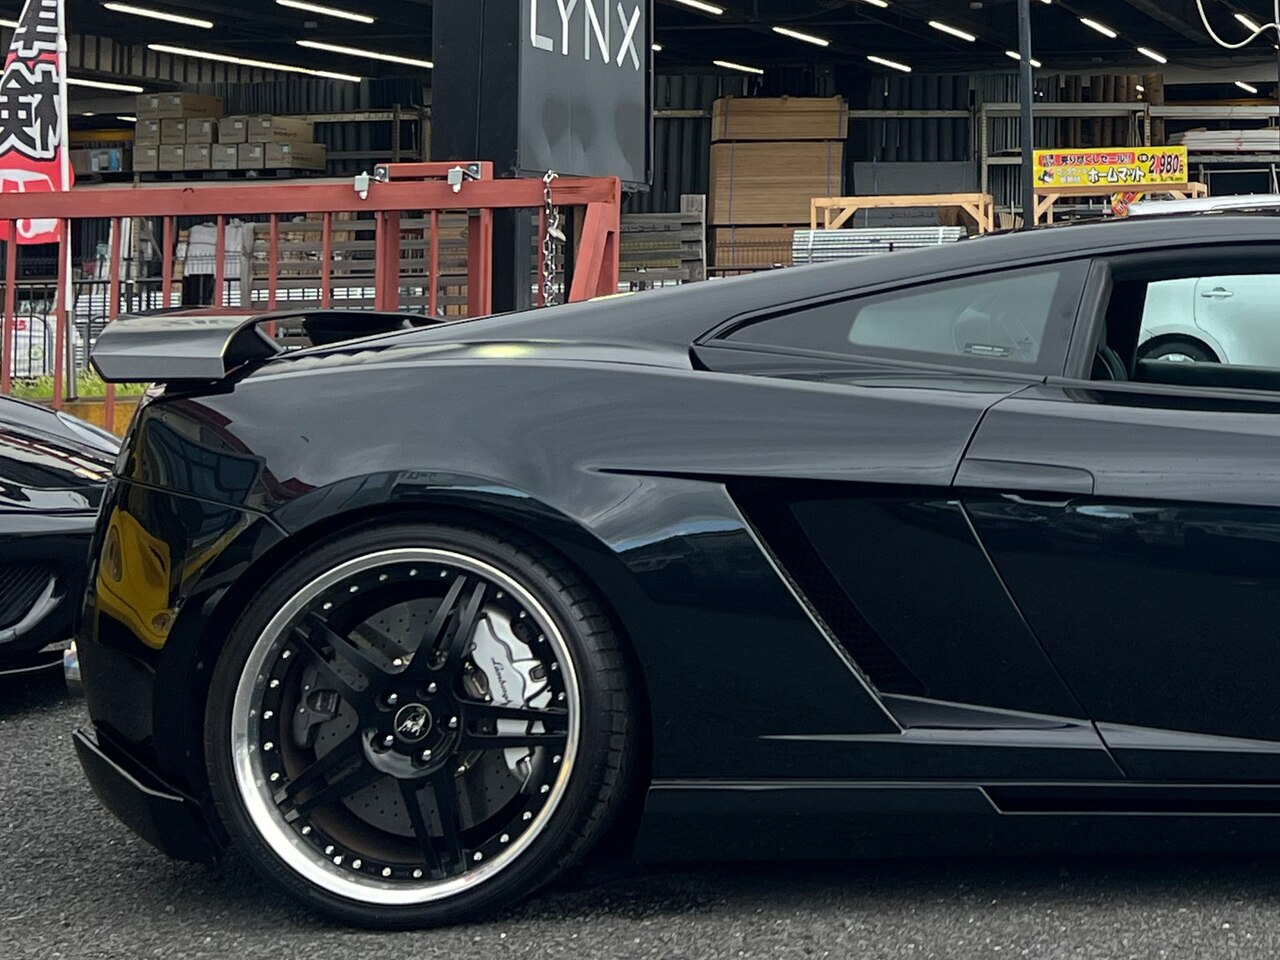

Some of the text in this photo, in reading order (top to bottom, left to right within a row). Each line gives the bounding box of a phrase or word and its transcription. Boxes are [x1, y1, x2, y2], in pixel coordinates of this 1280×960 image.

[1088, 166, 1145, 184] ホームマット
